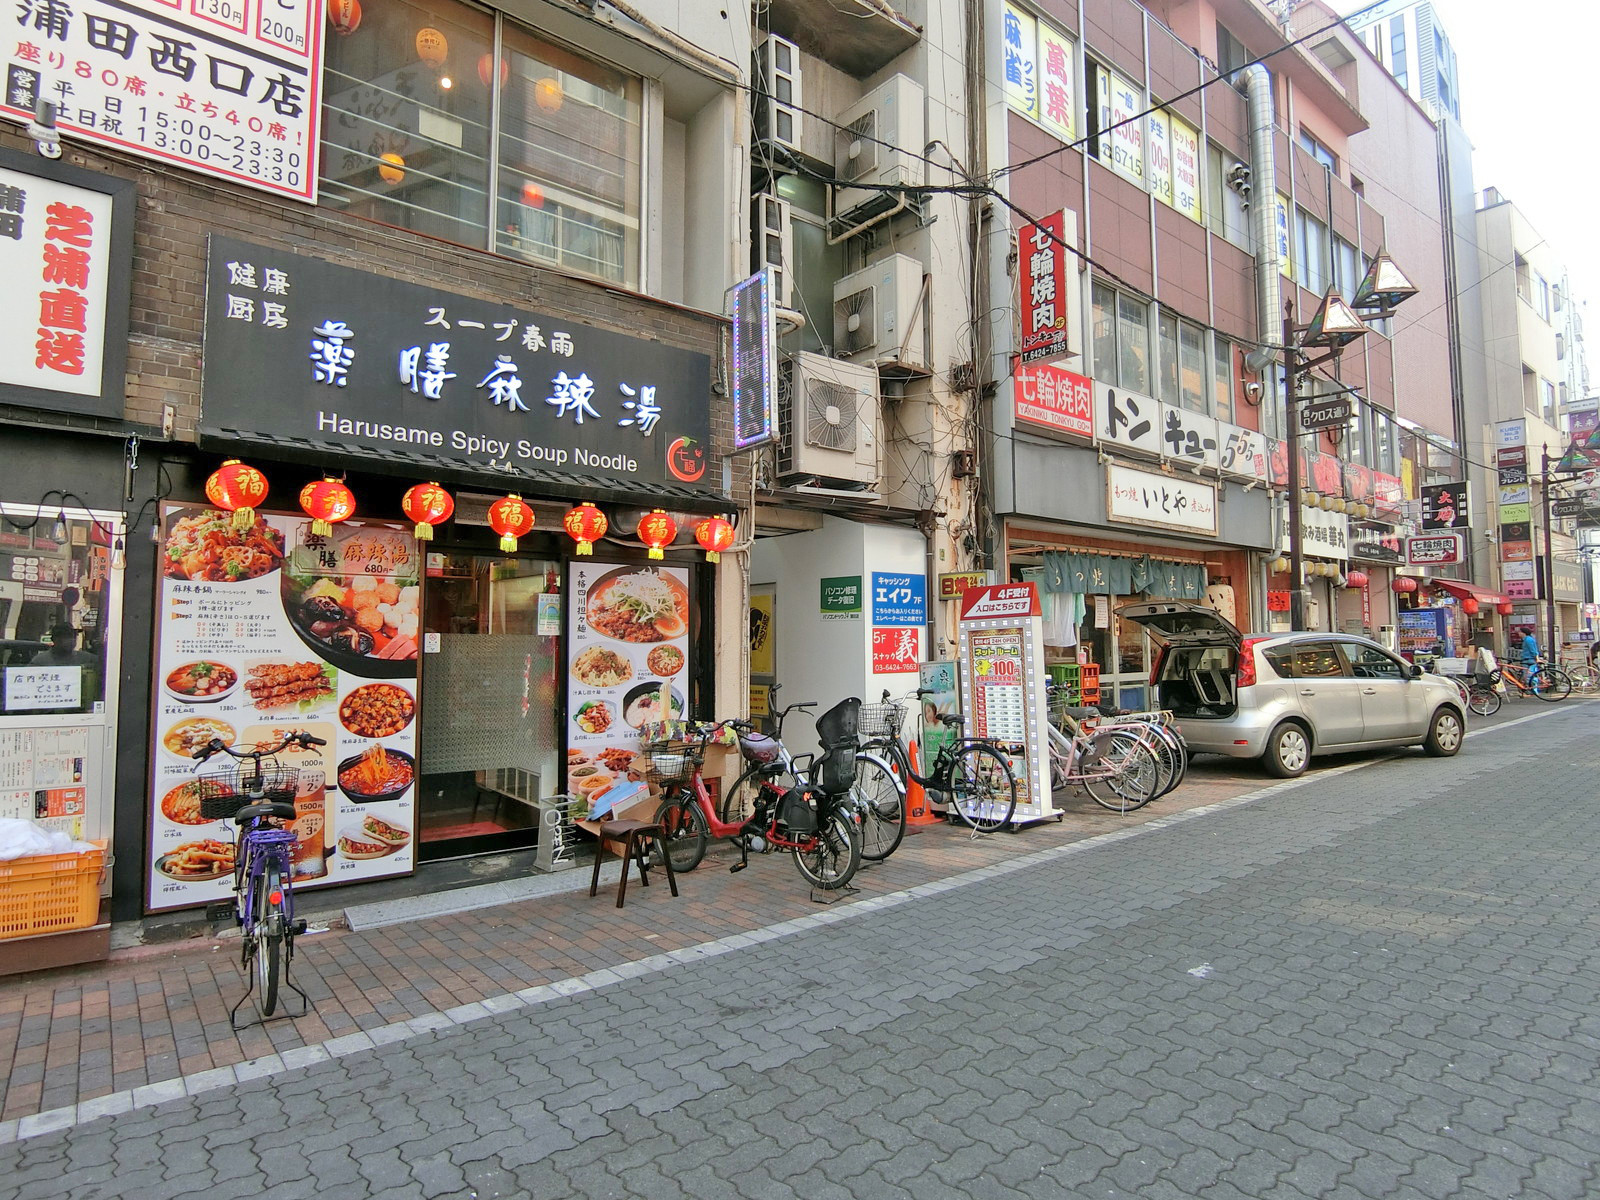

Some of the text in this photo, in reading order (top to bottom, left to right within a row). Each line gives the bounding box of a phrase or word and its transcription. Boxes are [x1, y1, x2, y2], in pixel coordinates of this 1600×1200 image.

[262, 18, 304, 47] 200円
[16, 0, 306, 119] 蒲田西口店
[1004, 8, 1022, 88] 麻雀
[13, 69, 34, 108] 営業
[1023, 59, 1036, 112] クラブ
[1045, 38, 1070, 128] 萬葉
[1117, 90, 1134, 111] 一般
[1114, 108, 1141, 148] 250円
[1114, 145, 1142, 177] 6715
[1180, 191, 1195, 210] 3F
[35, 201, 94, 376] 芝浦直送
[227, 261, 290, 296] 健康
[1029, 222, 1056, 333] 七輪焼肉
[227, 294, 288, 329] 厨房
[1055, 319, 1064, 328] 2F
[424, 307, 575, 357] スープ春雨
[1017, 369, 1090, 418] 七輪焼肉
[1019, 403, 1048, 420] YAKINIKU
[1050, 412, 1074, 427] TONKYU
[1108, 389, 1217, 459] トンキュー
[1310, 405, 1350, 423] クロス通り
[318, 411, 638, 472] Harusame Spicy Soup Noodle
[1115, 485, 1211, 516] もつ焼 いとや 煮込み
[499, 500, 524, 526] 福
[1412, 551, 1440, 559] トンキュー
[1413, 540, 1453, 549] 七輪焼肉
[825, 586, 857, 596] パソコン修理
[878, 577, 910, 586] キャッシング
[998, 587, 1030, 600] 4F受付
[828, 596, 855, 605] データ復旧
[876, 588, 922, 605] エイワ 7F
[976, 601, 1028, 612] 入口はこちらです
[875, 607, 923, 615] こちらからお入りください
[873, 631, 887, 644] 5F
[896, 629, 918, 664] 義
[873, 652, 896, 660] スナック
[997, 647, 1018, 655] ルーム
[36, 684, 72, 693] できます
[301, 759, 324, 767] 1000円
[299, 803, 322, 811] 1500円
